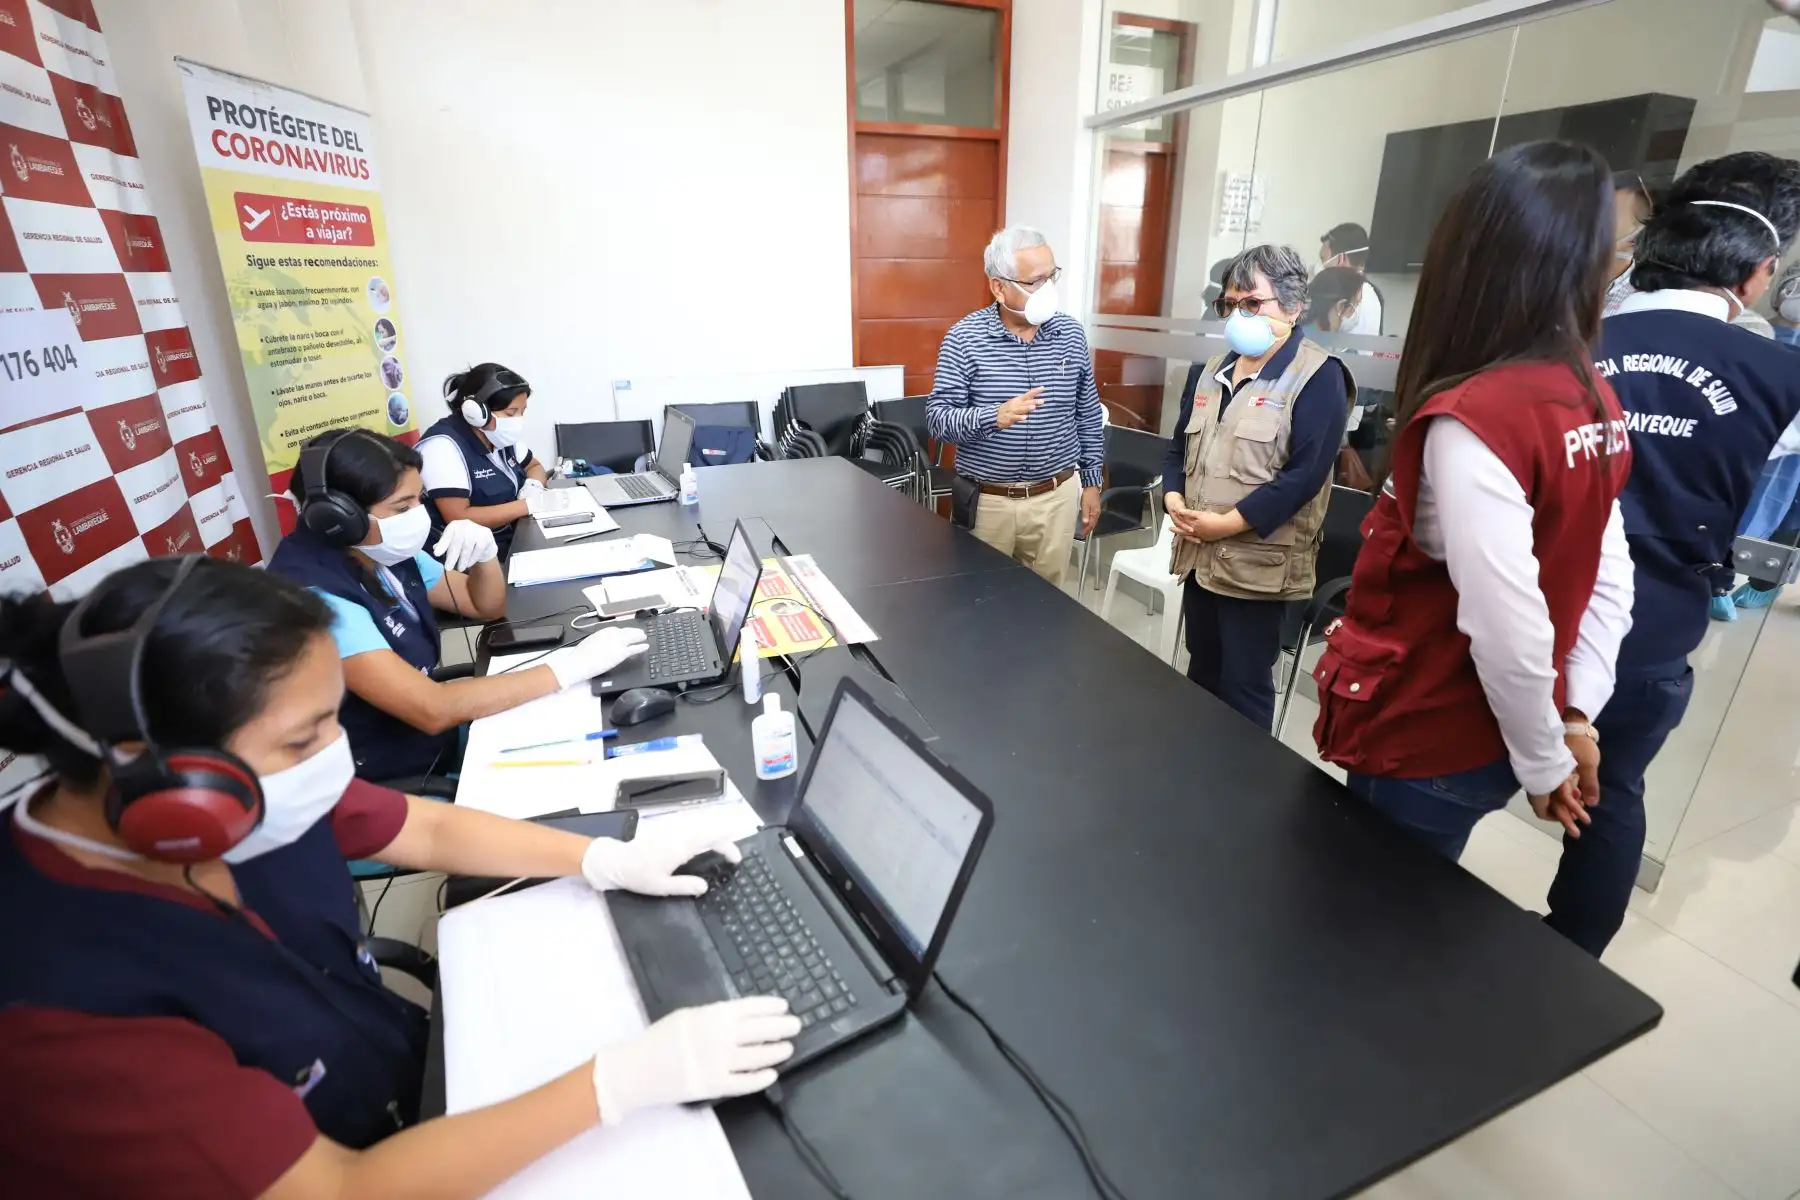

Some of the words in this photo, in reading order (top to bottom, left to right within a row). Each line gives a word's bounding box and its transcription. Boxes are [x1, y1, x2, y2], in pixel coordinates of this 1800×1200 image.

[206, 95, 329, 146] PROTÉGETE
[332, 126, 364, 152] DEL
[211, 128, 370, 181] CORONAVIRUS
[281, 202, 319, 221] ¿Estás
[321, 206, 367, 225] próximo
[306, 227, 315, 239] a
[316, 225, 353, 244] viajar?
[246, 254, 276, 270] Sigue
[278, 257, 302, 267] estas
[303, 256, 379, 268] recomendaciones:
[257, 301, 273, 310] agua
[315, 330, 329, 338] boca
[0, 349, 40, 381] 176
[43, 343, 78, 373] 404
[275, 385, 295, 396] Lávate
[323, 377, 339, 387] antes
[1622, 353, 1689, 379] REGIONAL
[1685, 365, 1713, 388] DE
[1701, 379, 1738, 416] SALUD
[278, 396, 293, 408] ojos,
[293, 393, 308, 404] nariz
[284, 428, 299, 438] Evita
[329, 415, 349, 426] directo
[287, 440, 298, 449] con
[5, 462, 39, 479] GERENCIA
[38, 452, 66, 467] REGIONAL
[65, 449, 74, 458] DE
[73, 443, 91, 455] SALUD
[72, 512, 109, 536] LAMBAYEQUE
[0, 555, 21, 571] SALUD
